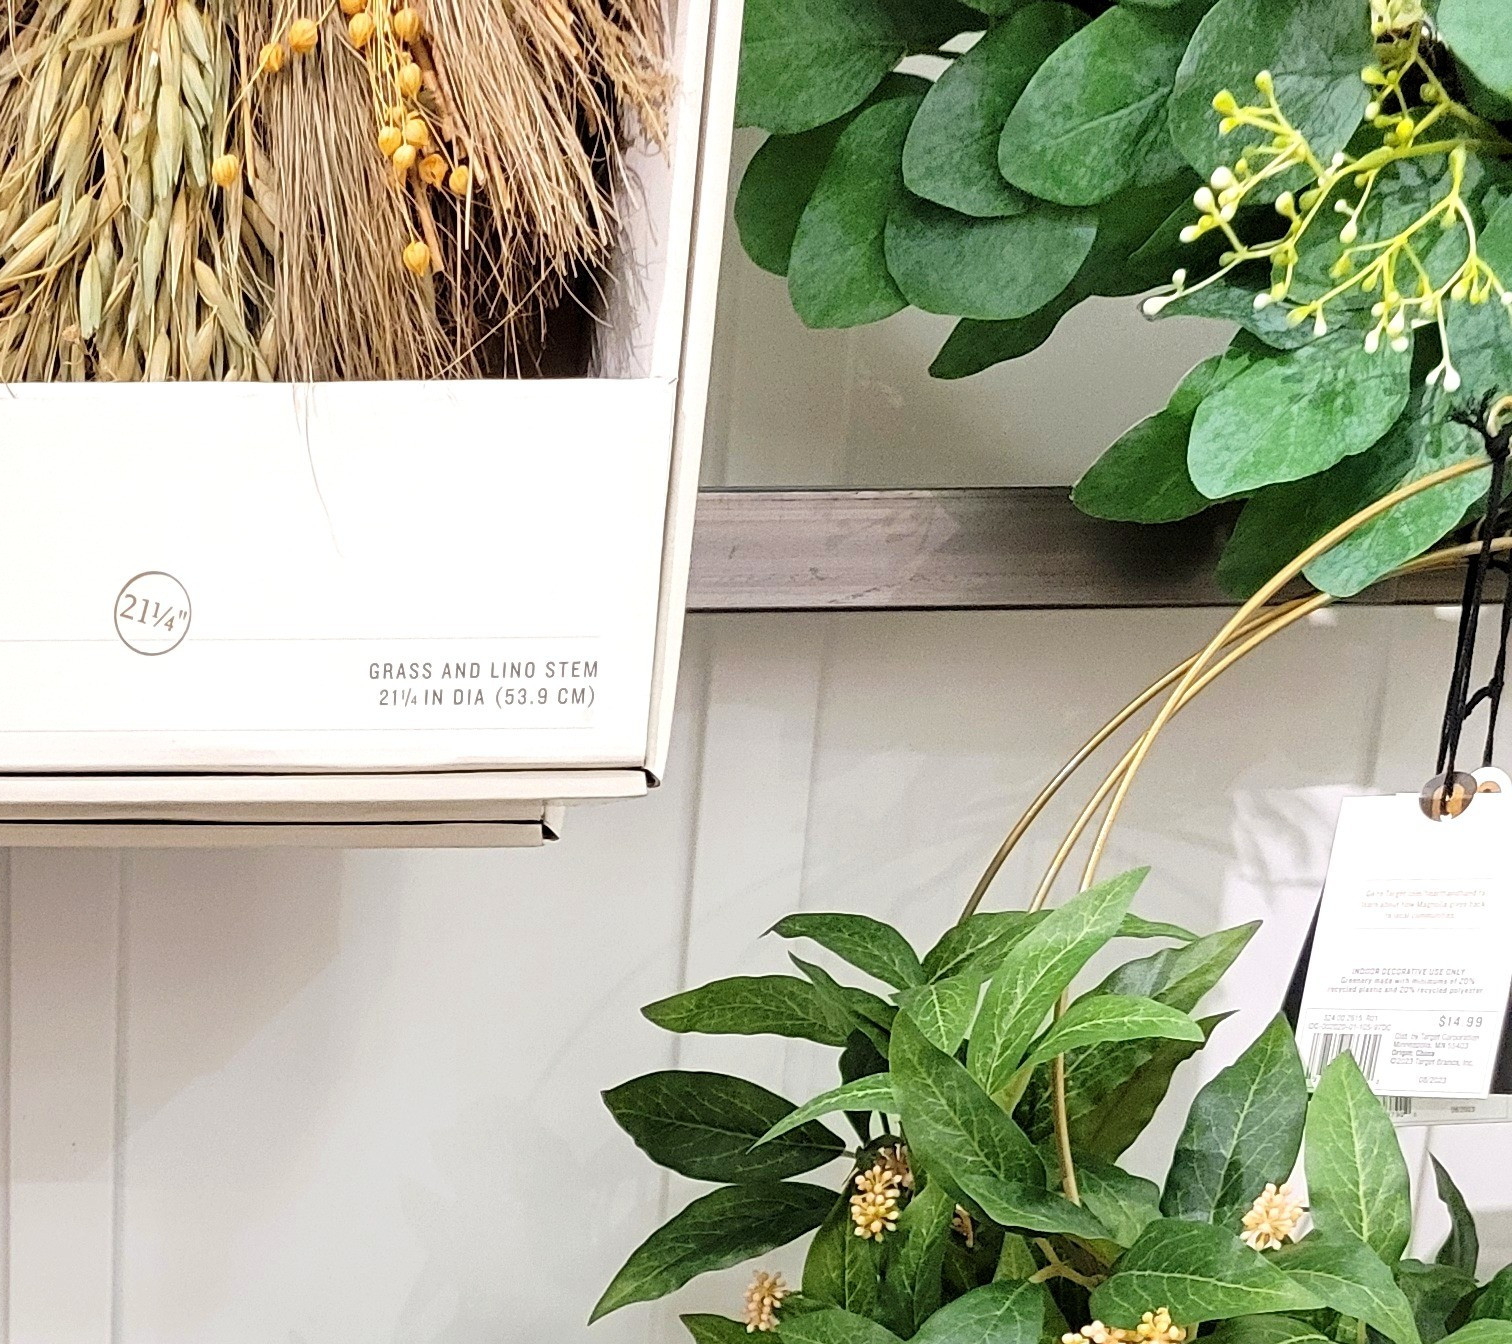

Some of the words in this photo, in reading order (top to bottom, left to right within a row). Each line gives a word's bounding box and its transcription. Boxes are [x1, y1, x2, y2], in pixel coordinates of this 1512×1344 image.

[368, 662, 433, 680] GRASS
[441, 662, 481, 679] AND
[490, 661, 536, 679] LINO
[545, 660, 599, 678] STEM
[424, 688, 444, 706] IN
[453, 687, 485, 706] DIA
[495, 686, 548, 709] (53.9
[557, 685, 595, 708] CM)
[1428, 968, 1444, 976] USE
[1445, 968, 1466, 976] ONLY
